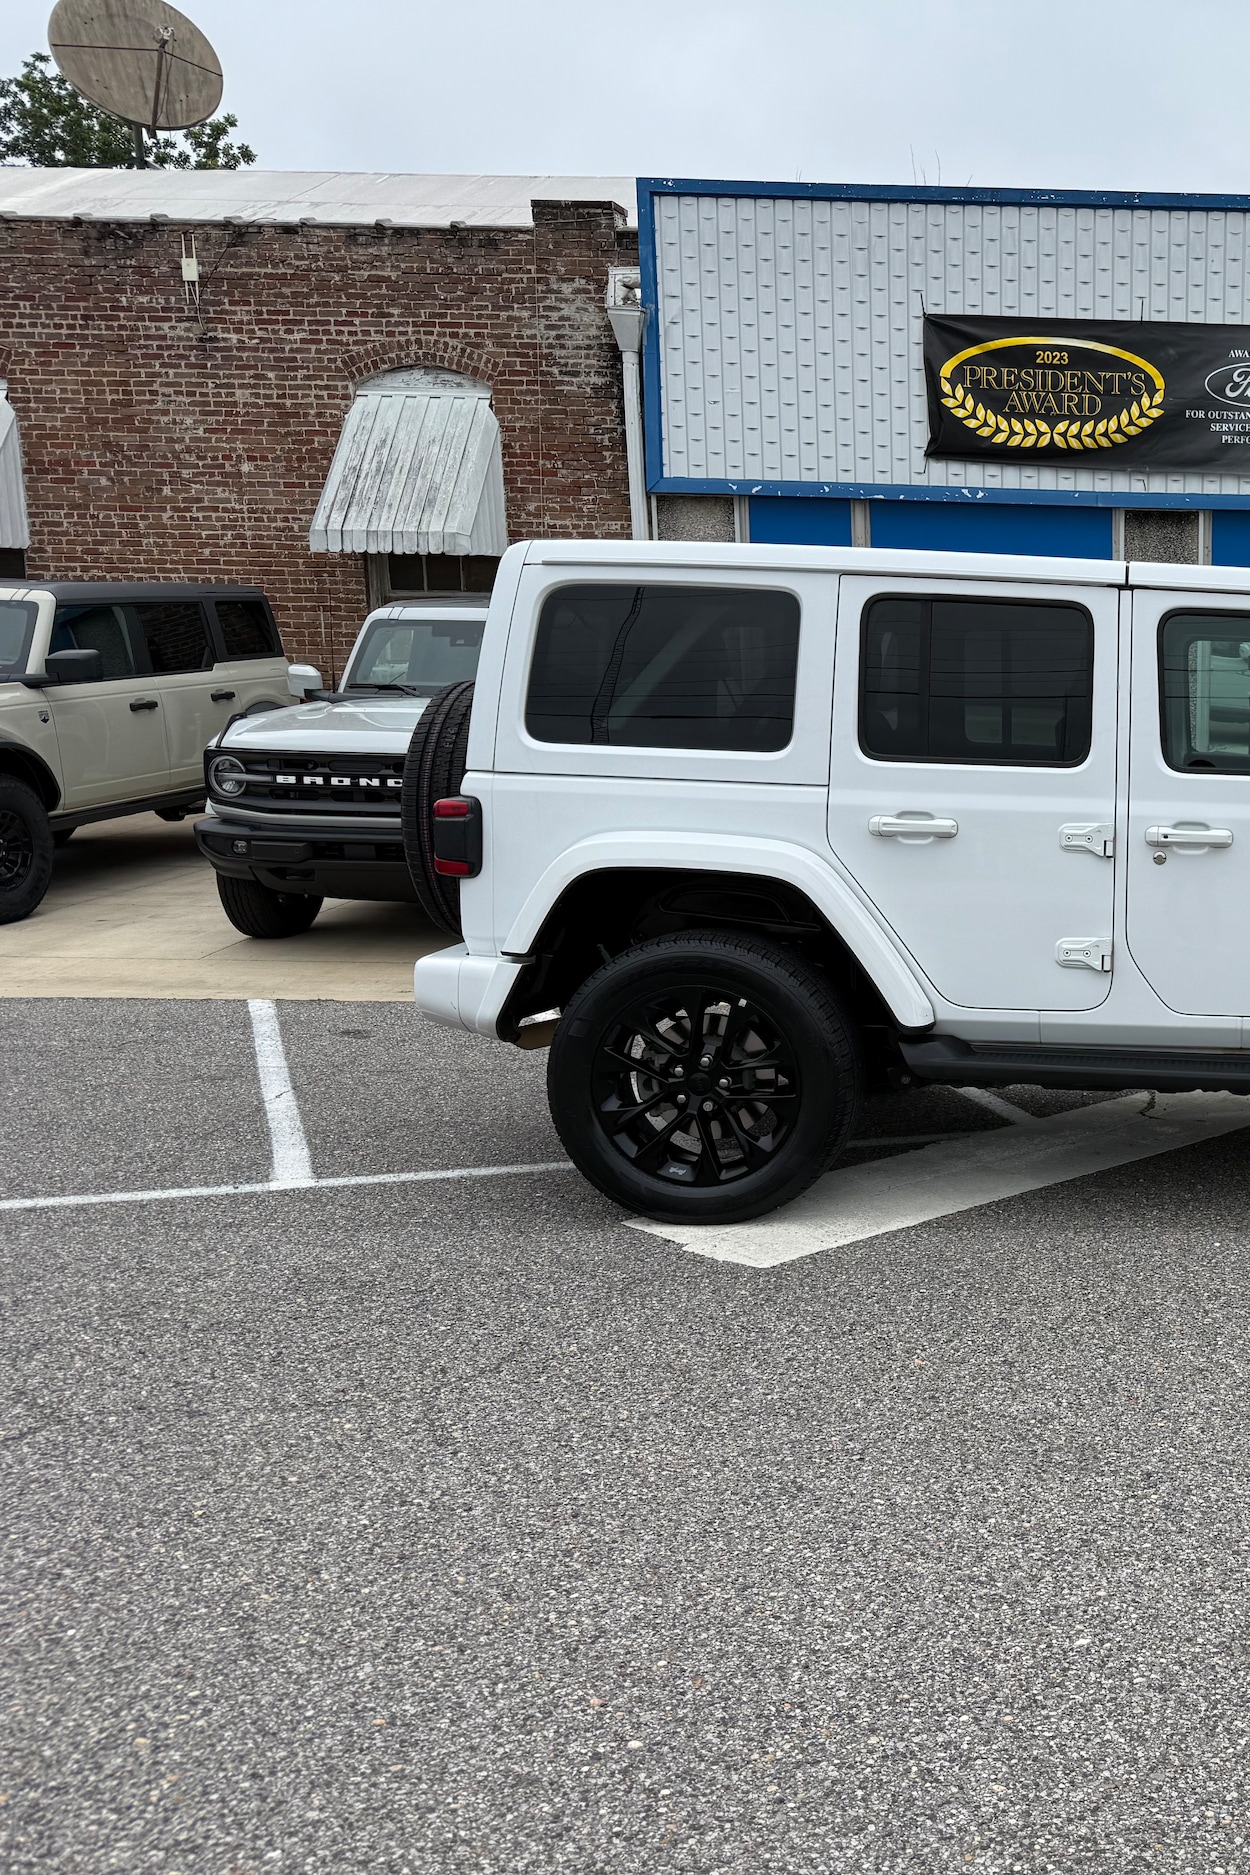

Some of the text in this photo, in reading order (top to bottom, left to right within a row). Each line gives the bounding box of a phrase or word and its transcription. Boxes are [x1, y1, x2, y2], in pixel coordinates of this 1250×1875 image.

[1035, 350, 1069, 365] 2023
[963, 365, 1146, 396] PRESIDENT'S
[1002, 391, 1102, 417] AWARD
[1185, 409, 1206, 420] FOR
[276, 775, 403, 787] BRONC
